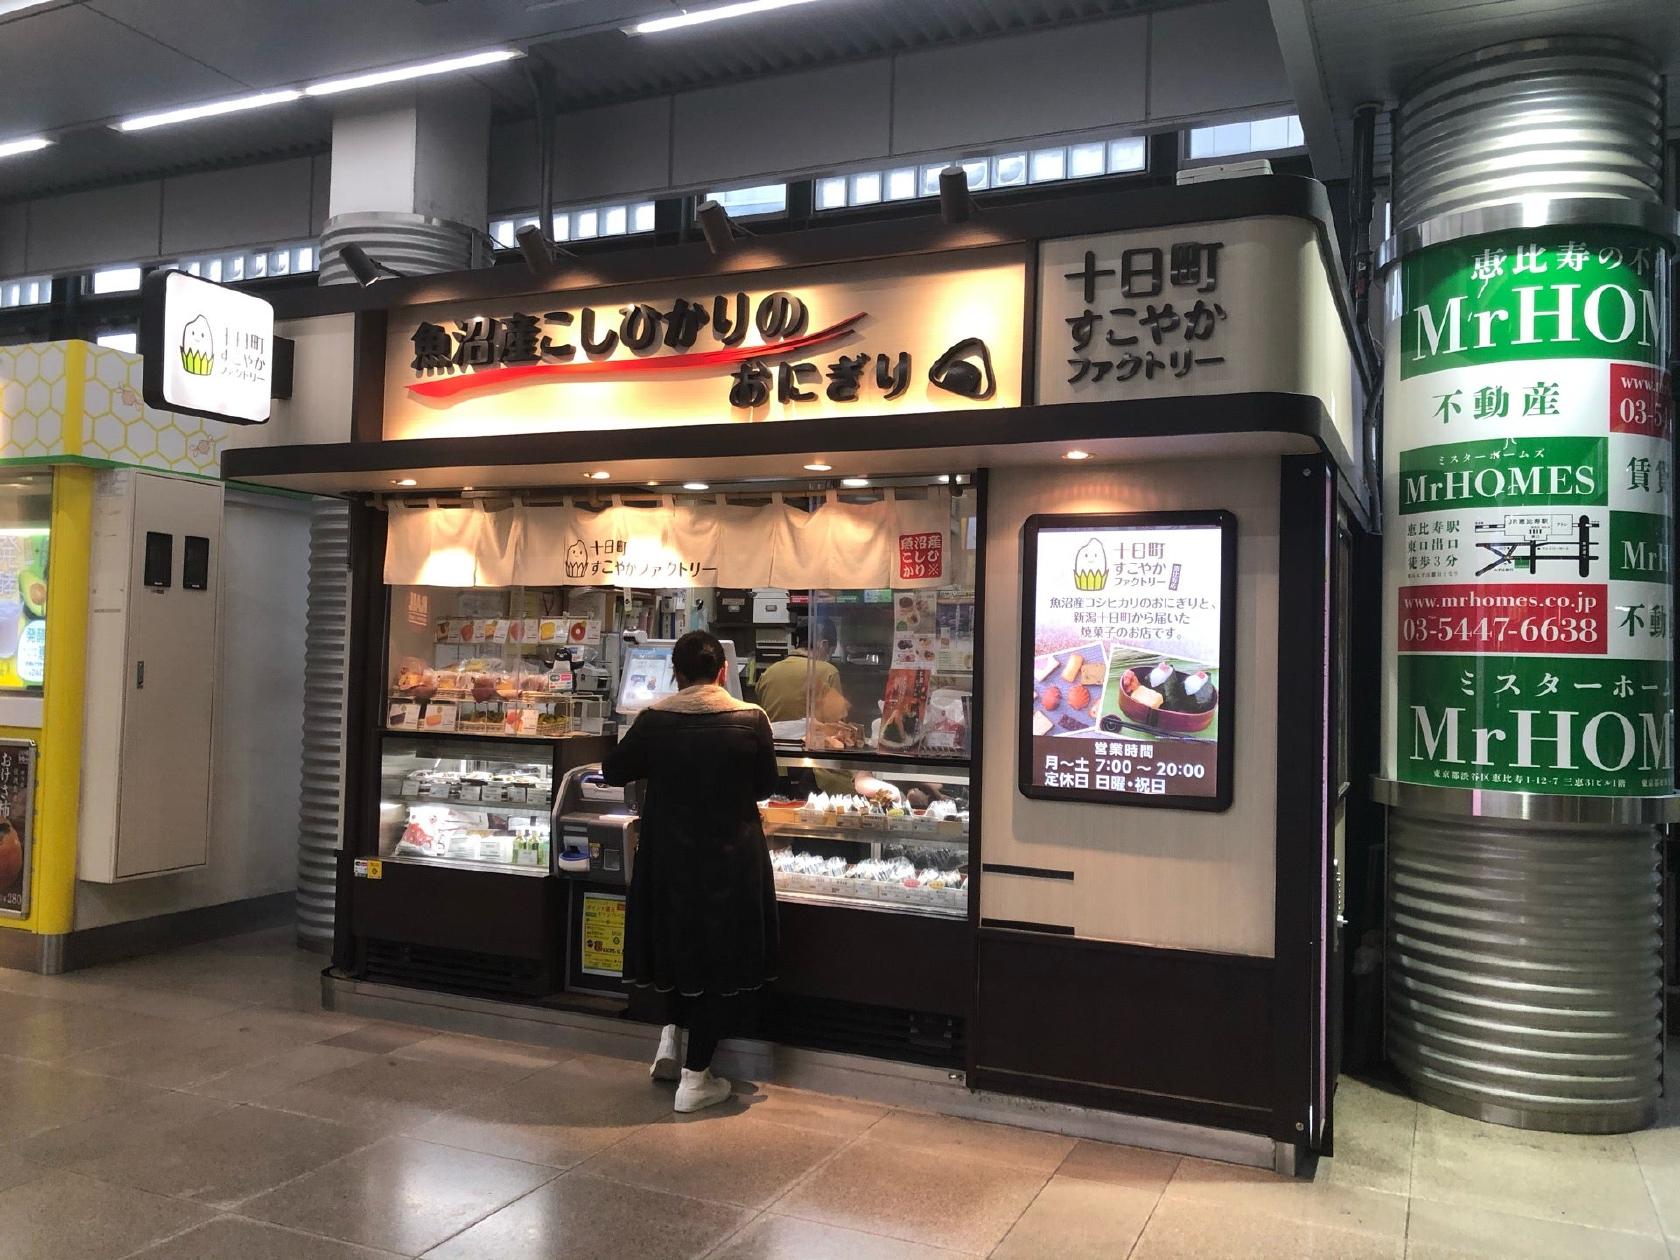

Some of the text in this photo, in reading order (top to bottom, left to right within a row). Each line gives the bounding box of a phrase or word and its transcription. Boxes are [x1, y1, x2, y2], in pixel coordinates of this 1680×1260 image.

[1064, 242, 1224, 303] 十日町
[411, 291, 808, 371] 魚沼産こしひかりの
[1066, 300, 1227, 352] すこやか
[1067, 348, 1225, 383] ファクトリー
[731, 352, 911, 407] おにぎり
[1432, 381, 1560, 424] 不動産
[1405, 466, 1596, 505] MrHOMES
[1407, 520, 1460, 536] 恵比寿駅
[590, 539, 627, 556] 十日町
[1113, 542, 1165, 559] 十日町
[1408, 537, 1459, 552] 東口出口
[1114, 562, 1166, 576] すこやか
[1114, 576, 1166, 587] ファクトリー
[1404, 591, 1597, 614] www.mrhomes.co.jp
[1074, 611, 1190, 625] 新潟十日町から届いた
[1081, 626, 1182, 640] 焼菓子のお店です。
[1403, 616, 1598, 643] 03-5447-6638
[1094, 742, 1153, 758] 営業時間
[1045, 755, 1089, 772] 月～土
[1095, 758, 1132, 774] 7:00
[1156, 762, 1205, 779] 20:00
[1044, 772, 1166, 794] 定休日 日曜・祝日
